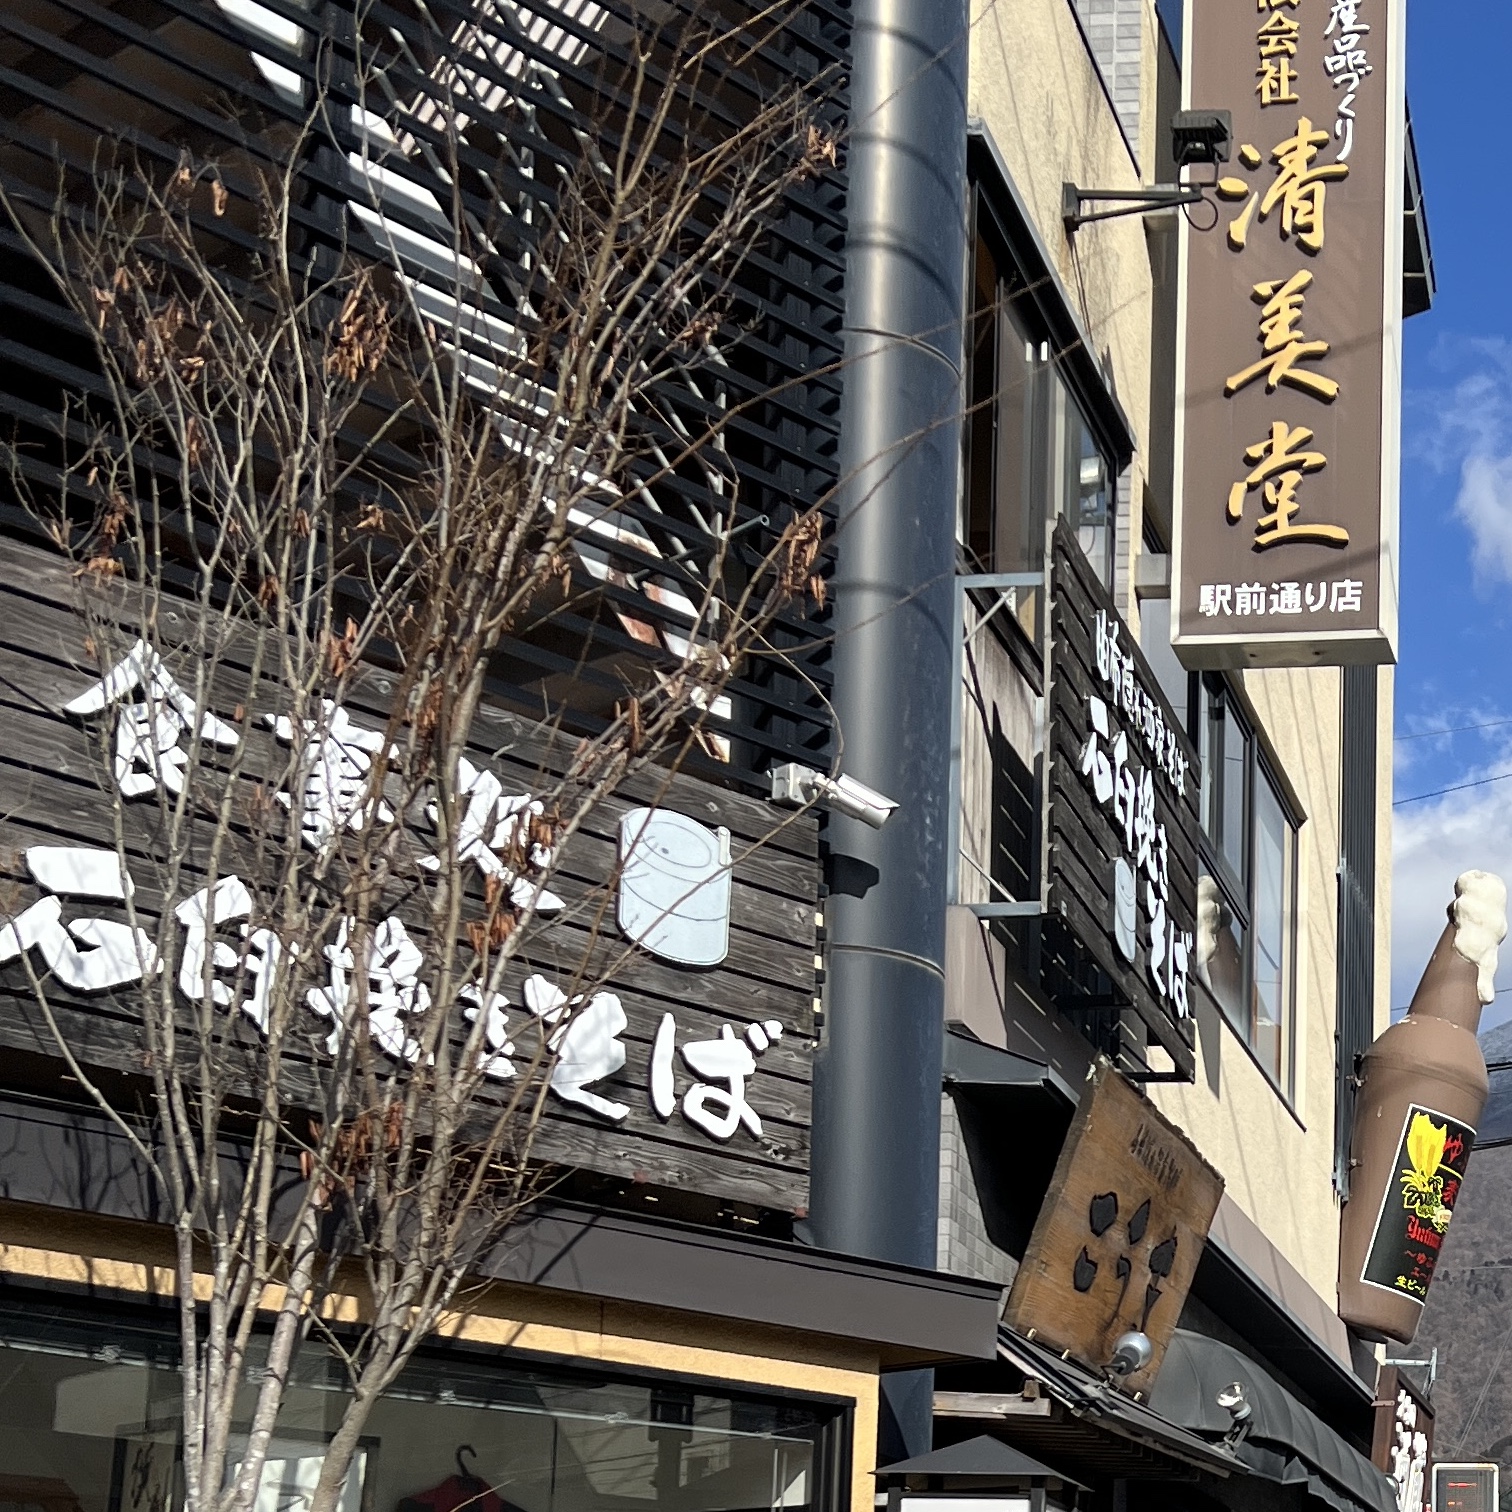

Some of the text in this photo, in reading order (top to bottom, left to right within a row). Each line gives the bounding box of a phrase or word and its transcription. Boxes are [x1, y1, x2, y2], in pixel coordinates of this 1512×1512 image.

[1219, 0, 1349, 549] 会社 清美堂
[1199, 579, 1364, 617] 駅前通り店
